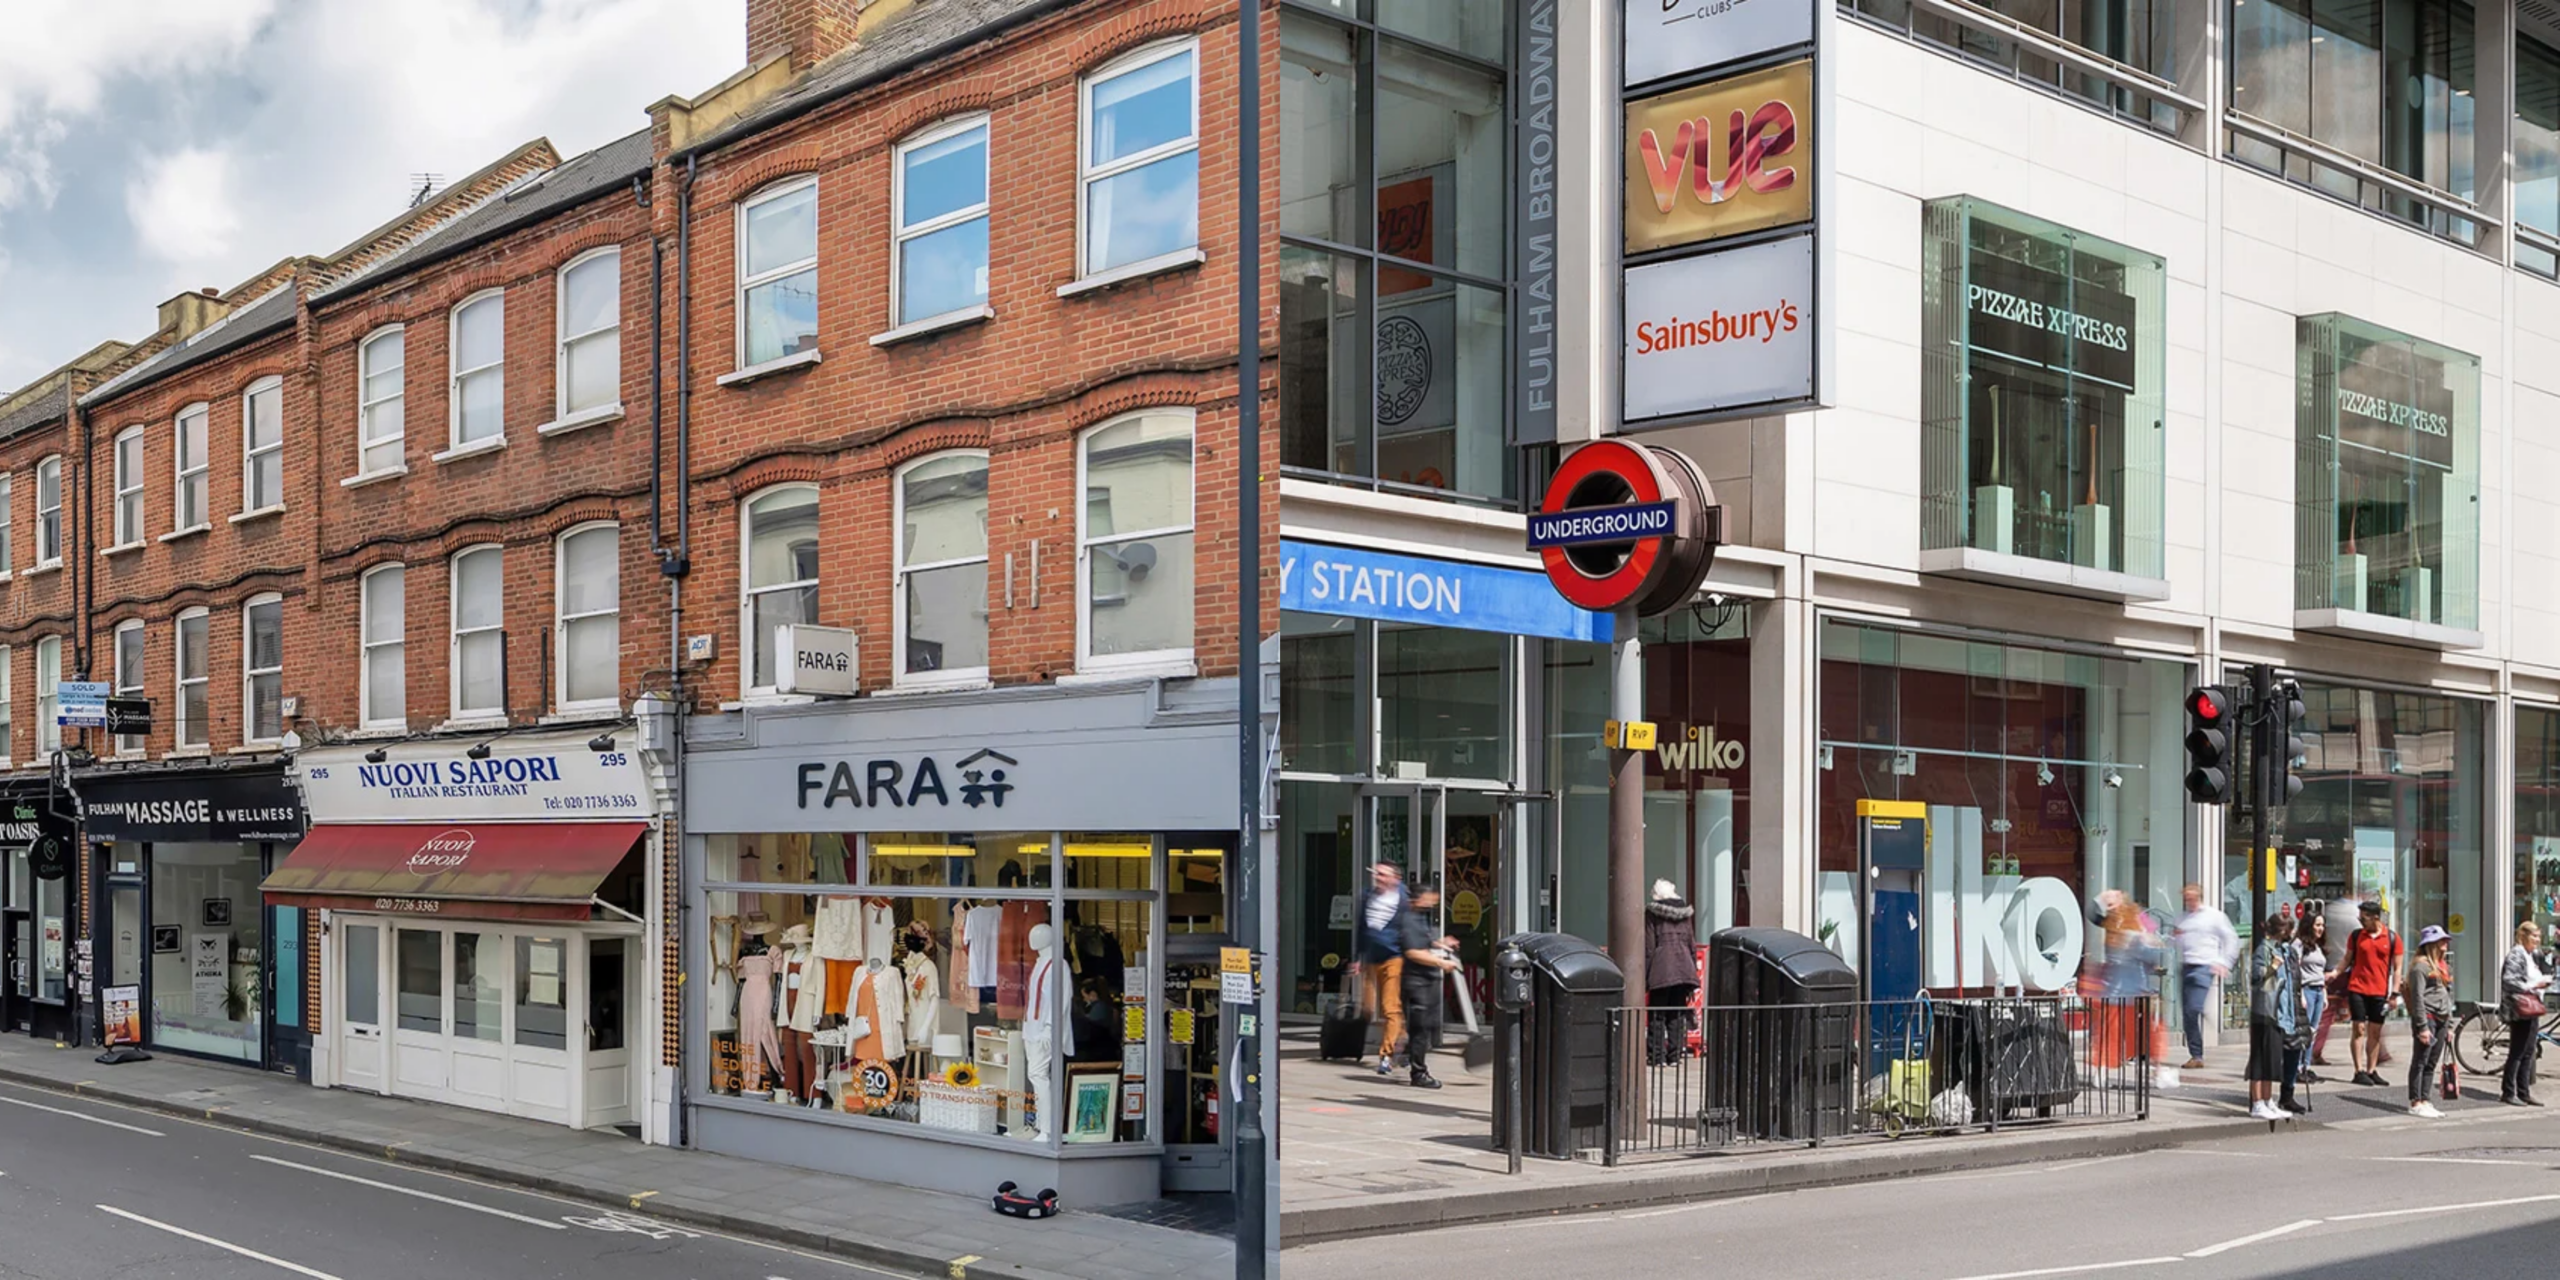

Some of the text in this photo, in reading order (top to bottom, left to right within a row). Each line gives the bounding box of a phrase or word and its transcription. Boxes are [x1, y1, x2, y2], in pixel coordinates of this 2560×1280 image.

[1697, 0, 1732, 18] CLUBS
[1639, 100, 1797, 213] vue
[1529, 235, 1553, 411] FULHAM
[1637, 300, 1798, 354] Sainsbury's
[1534, 509, 1669, 540] UNDERGROUND
[1311, 560, 1461, 614] STATION
[799, 651, 835, 671] FARA
[72, 684, 96, 692] SOLD
[1632, 728, 1648, 739] RVP
[1657, 726, 1746, 771] wilko
[600, 753, 627, 767] 295
[310, 768, 329, 780] 295
[357, 756, 561, 788] NUOVI SAPORI
[390, 783, 528, 798] ITALIAN RESTAURANT
[797, 757, 949, 809] FARA
[544, 795, 637, 809] Tel: 020 7736 3363
[14, 805, 37, 819] Clinic
[88, 800, 294, 824] FULHAM MASSAGE & WELLNESS
[424, 840, 475, 851] NUOVI
[407, 854, 468, 867] SAPORI
[375, 898, 439, 913] 020 7736 3363
[283, 940, 297, 950] 293
[712, 1038, 756, 1056] REUSE
[712, 1056, 767, 1076] REDUCE
[853, 1058, 897, 1082] CELEBRATING
[712, 1074, 771, 1093] RECYCLE
[865, 1070, 887, 1089] 30
[930, 1092, 1007, 1110] TRANSFORMING
[1010, 1102, 1038, 1113] LIVES
[986, 1088, 1039, 1101] SHOPPING
